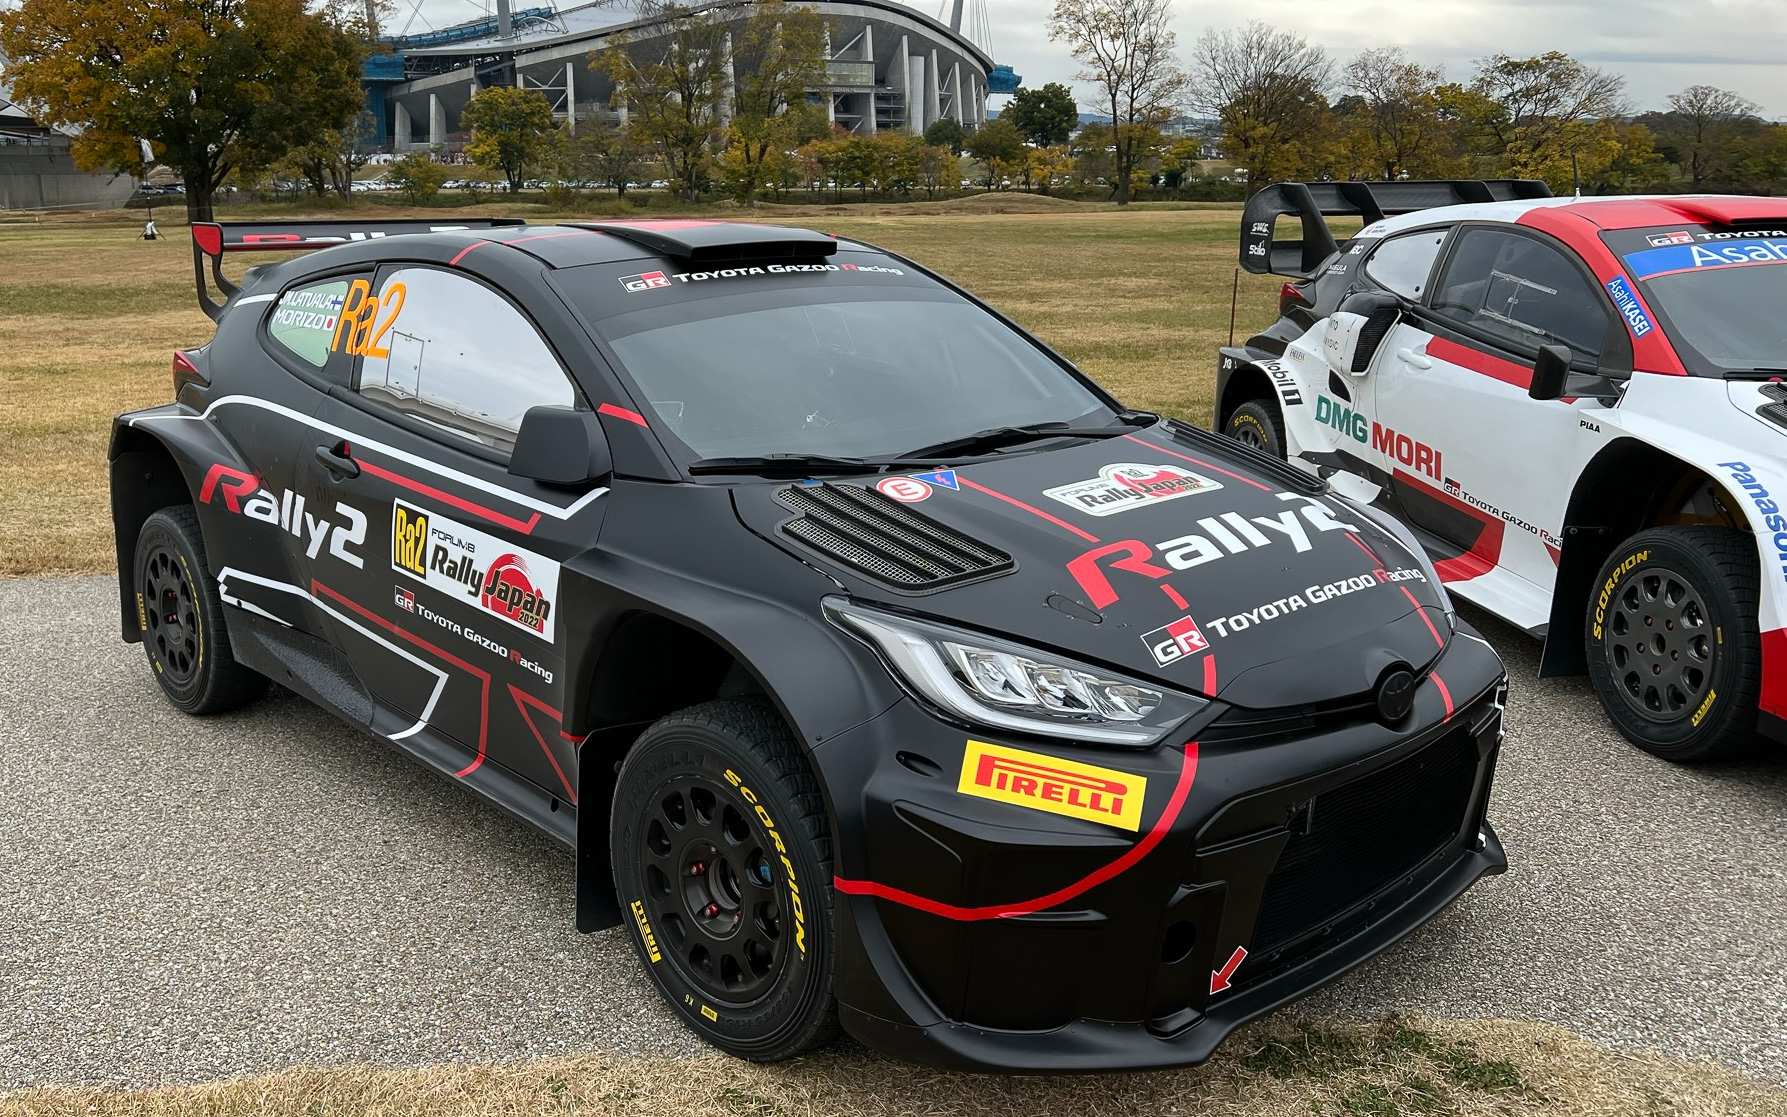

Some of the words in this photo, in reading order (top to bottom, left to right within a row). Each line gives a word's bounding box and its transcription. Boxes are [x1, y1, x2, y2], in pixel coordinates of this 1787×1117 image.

[1651, 236, 1690, 244] GR
[626, 277, 670, 291] GR
[673, 267, 762, 283] TOYOTA
[767, 264, 839, 273] GAZOO
[841, 264, 904, 276] Racing
[273, 308, 325, 329] MORIZO
[331, 278, 406, 359] Ra2
[1234, 415, 1268, 443] SCORPION
[1315, 394, 1368, 444] DMG
[1372, 421, 1442, 482] MORI
[1579, 419, 1600, 433] PIAA
[200, 463, 368, 570] Rally2
[889, 482, 918, 496] E
[1076, 486, 1147, 508] Rally
[1137, 475, 1202, 493] Japan
[1444, 483, 1459, 498] GR
[1461, 490, 1499, 517] TOYOTA
[1501, 510, 1538, 535] GAZOO
[395, 507, 427, 575] Ra2
[431, 527, 476, 553] FORUM8
[1067, 490, 1361, 609] Rally2
[430, 543, 484, 598] Rally
[485, 567, 551, 621] Japan
[1205, 594, 1307, 639] TOYOTA
[1305, 573, 1377, 604] GAZOO
[1372, 564, 1427, 584] Racing
[1593, 550, 1651, 640] SCORPION
[416, 603, 462, 636] TOYOTA
[463, 627, 508, 658] GAZOO
[510, 648, 553, 684] Racing
[518, 610, 539, 629] 2022
[974, 754, 1128, 815] PIRELLI
[723, 769, 806, 954] SCORPION
[630, 900, 662, 963] PIRELLI
